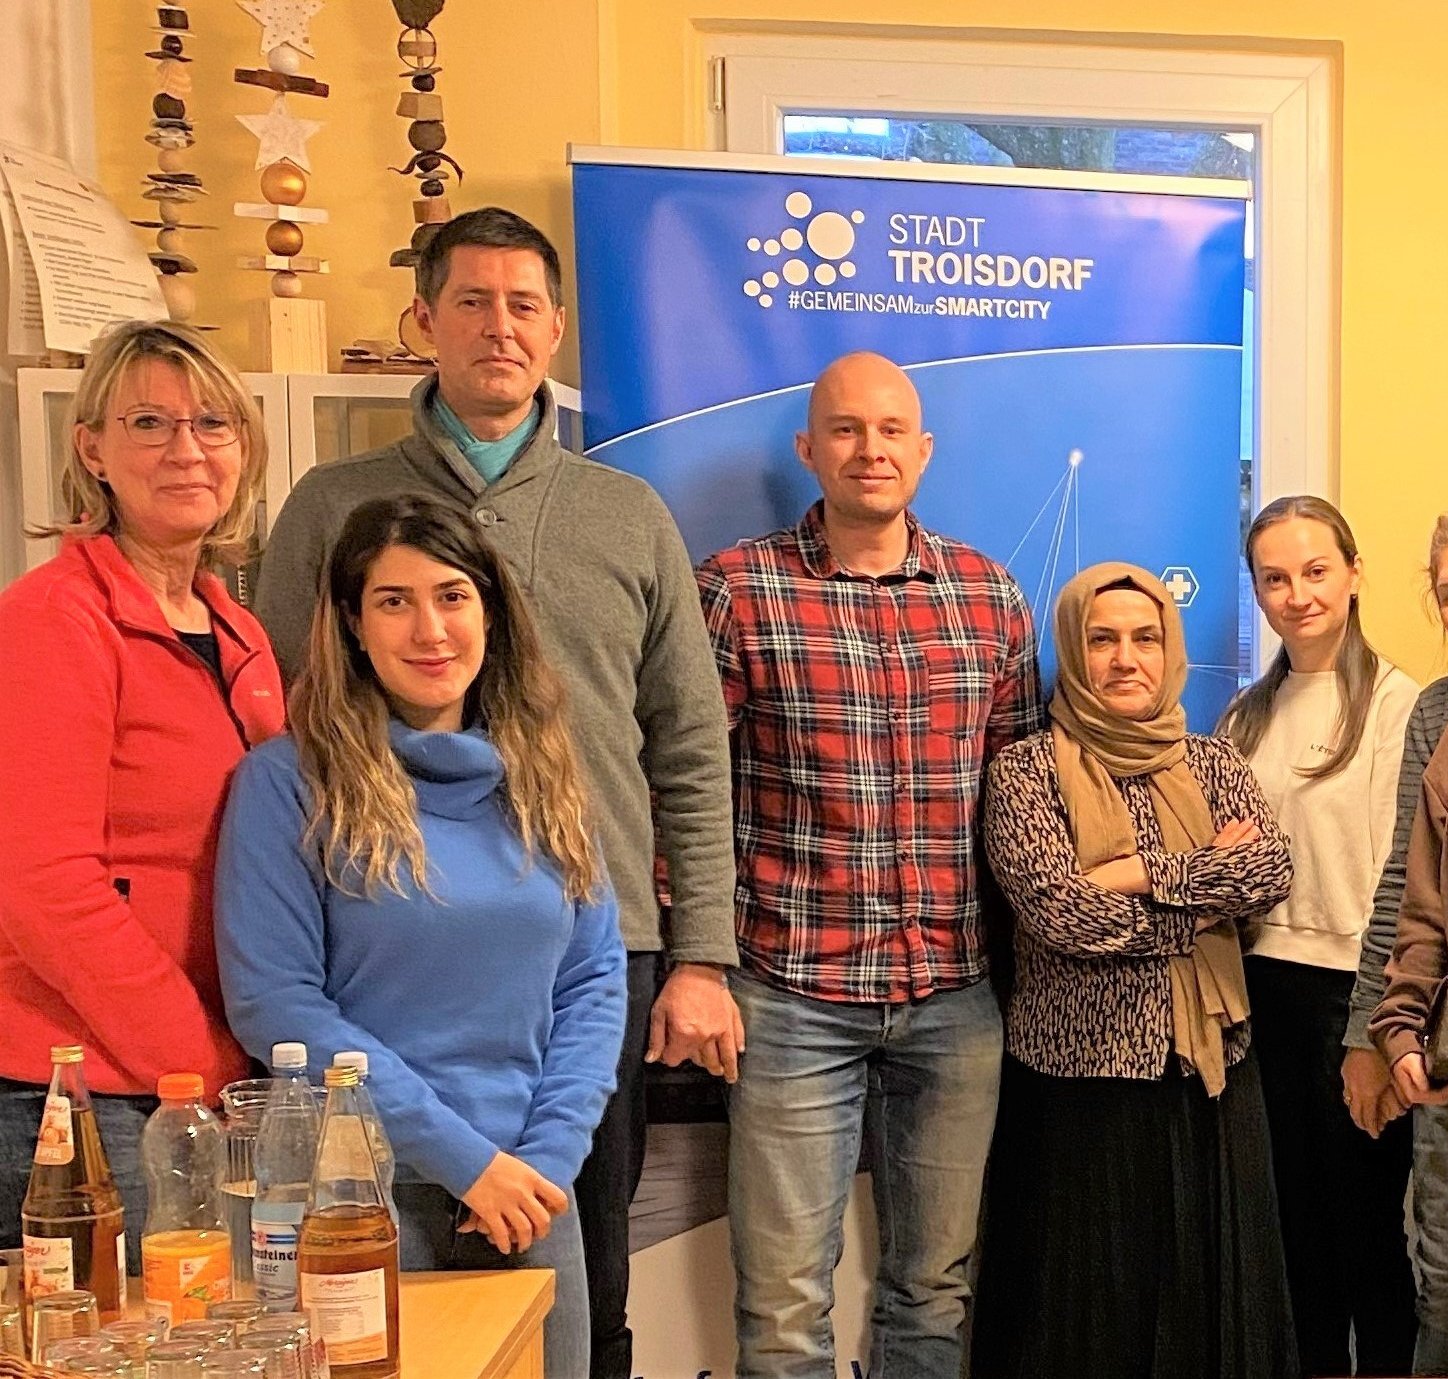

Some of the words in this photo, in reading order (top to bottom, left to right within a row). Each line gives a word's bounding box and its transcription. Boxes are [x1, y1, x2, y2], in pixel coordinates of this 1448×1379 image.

[888, 213, 986, 248] STADT
[887, 250, 1095, 291] TROISDORF
[788, 290, 1052, 320] #GEMEINSAMzurSMARTCITY
